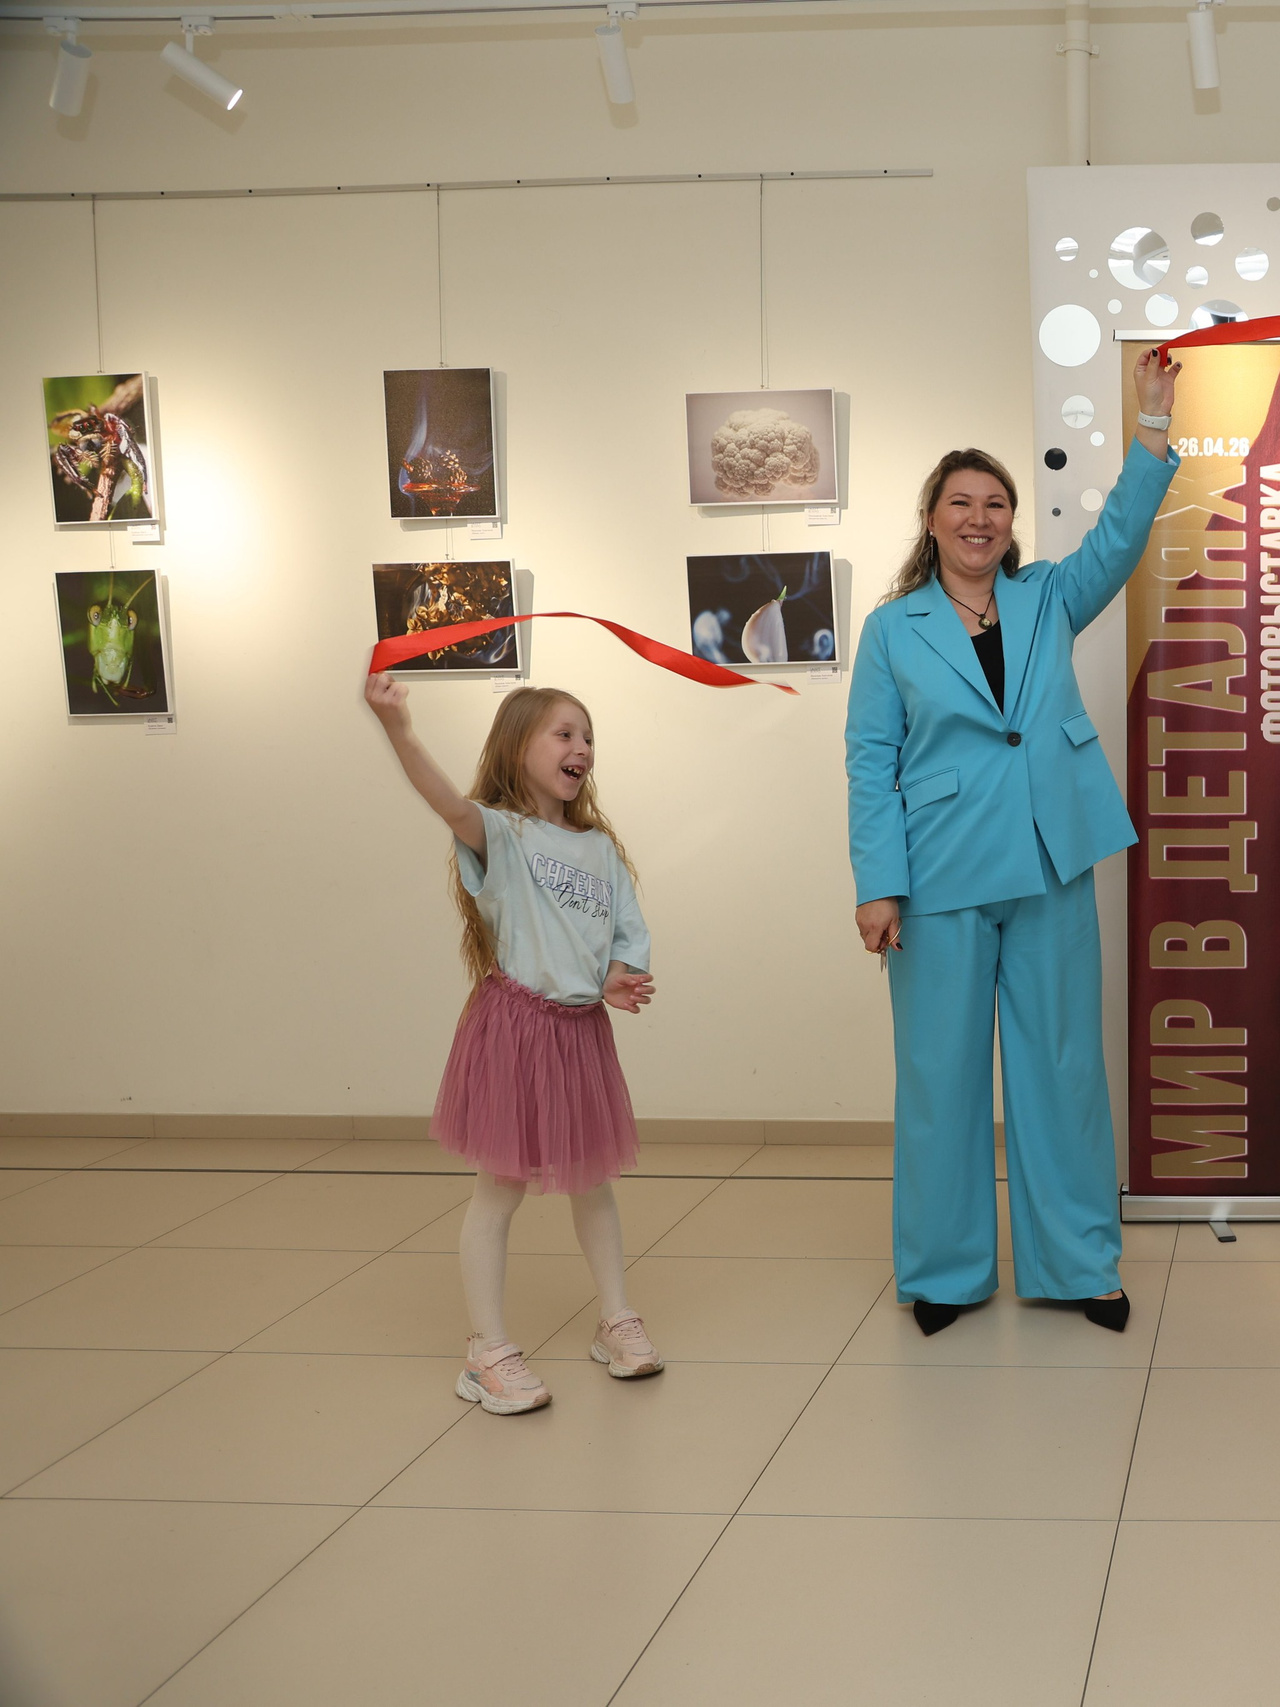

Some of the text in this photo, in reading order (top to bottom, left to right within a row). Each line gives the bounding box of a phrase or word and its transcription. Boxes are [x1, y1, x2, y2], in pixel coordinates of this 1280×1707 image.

[1168, 437, 1249, 457] -26.04.26
[1147, 464, 1257, 1178] МИР В ДЕТАЛЯХ
